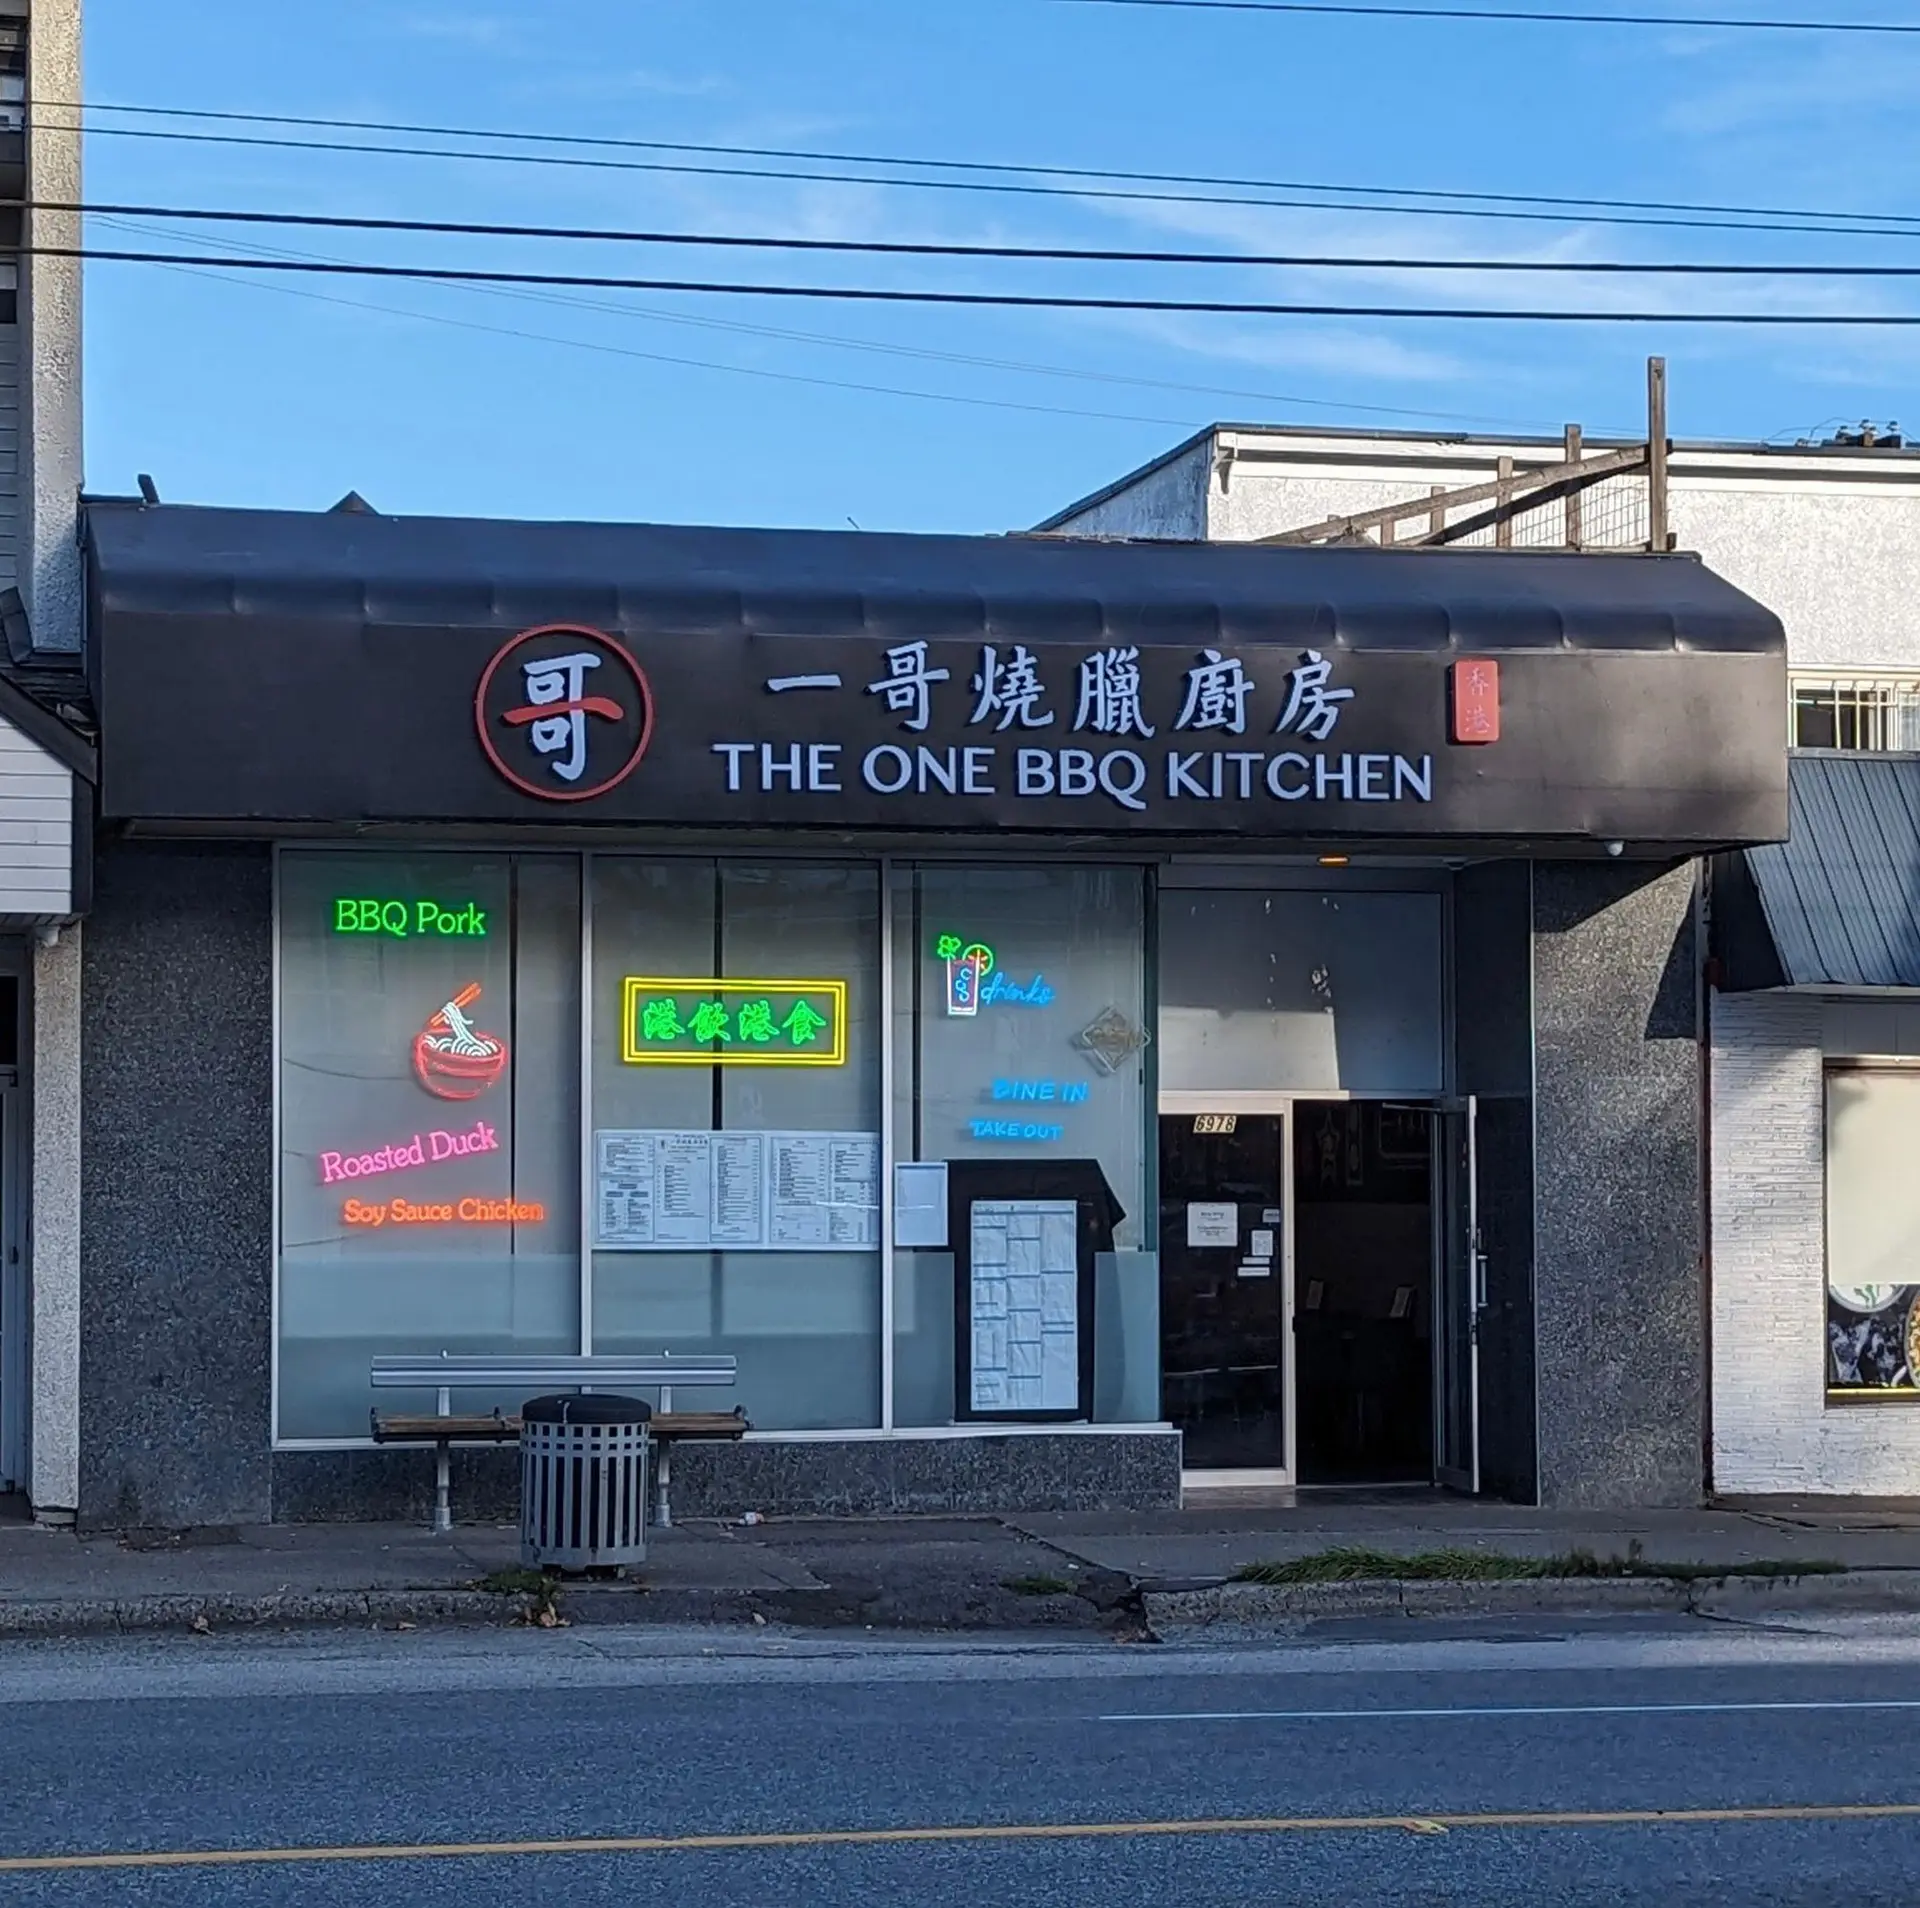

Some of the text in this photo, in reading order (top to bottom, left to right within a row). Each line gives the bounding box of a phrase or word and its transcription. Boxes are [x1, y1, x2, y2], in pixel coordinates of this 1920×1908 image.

[766, 640, 1355, 741] 一哥燒臘廚房
[503, 652, 624, 781] 哥
[713, 742, 1432, 810] THE ONE BBQ KITCHEN
[336, 899, 487, 936] BBQ Pork
[992, 1080, 1089, 1102] DINE IN
[970, 1120, 1065, 1140] TAKE OUT
[1195, 1114, 1234, 1131] 6978
[321, 1121, 498, 1184] Roasted Duck
[343, 1198, 545, 1227] Soy Sauce Chicken
